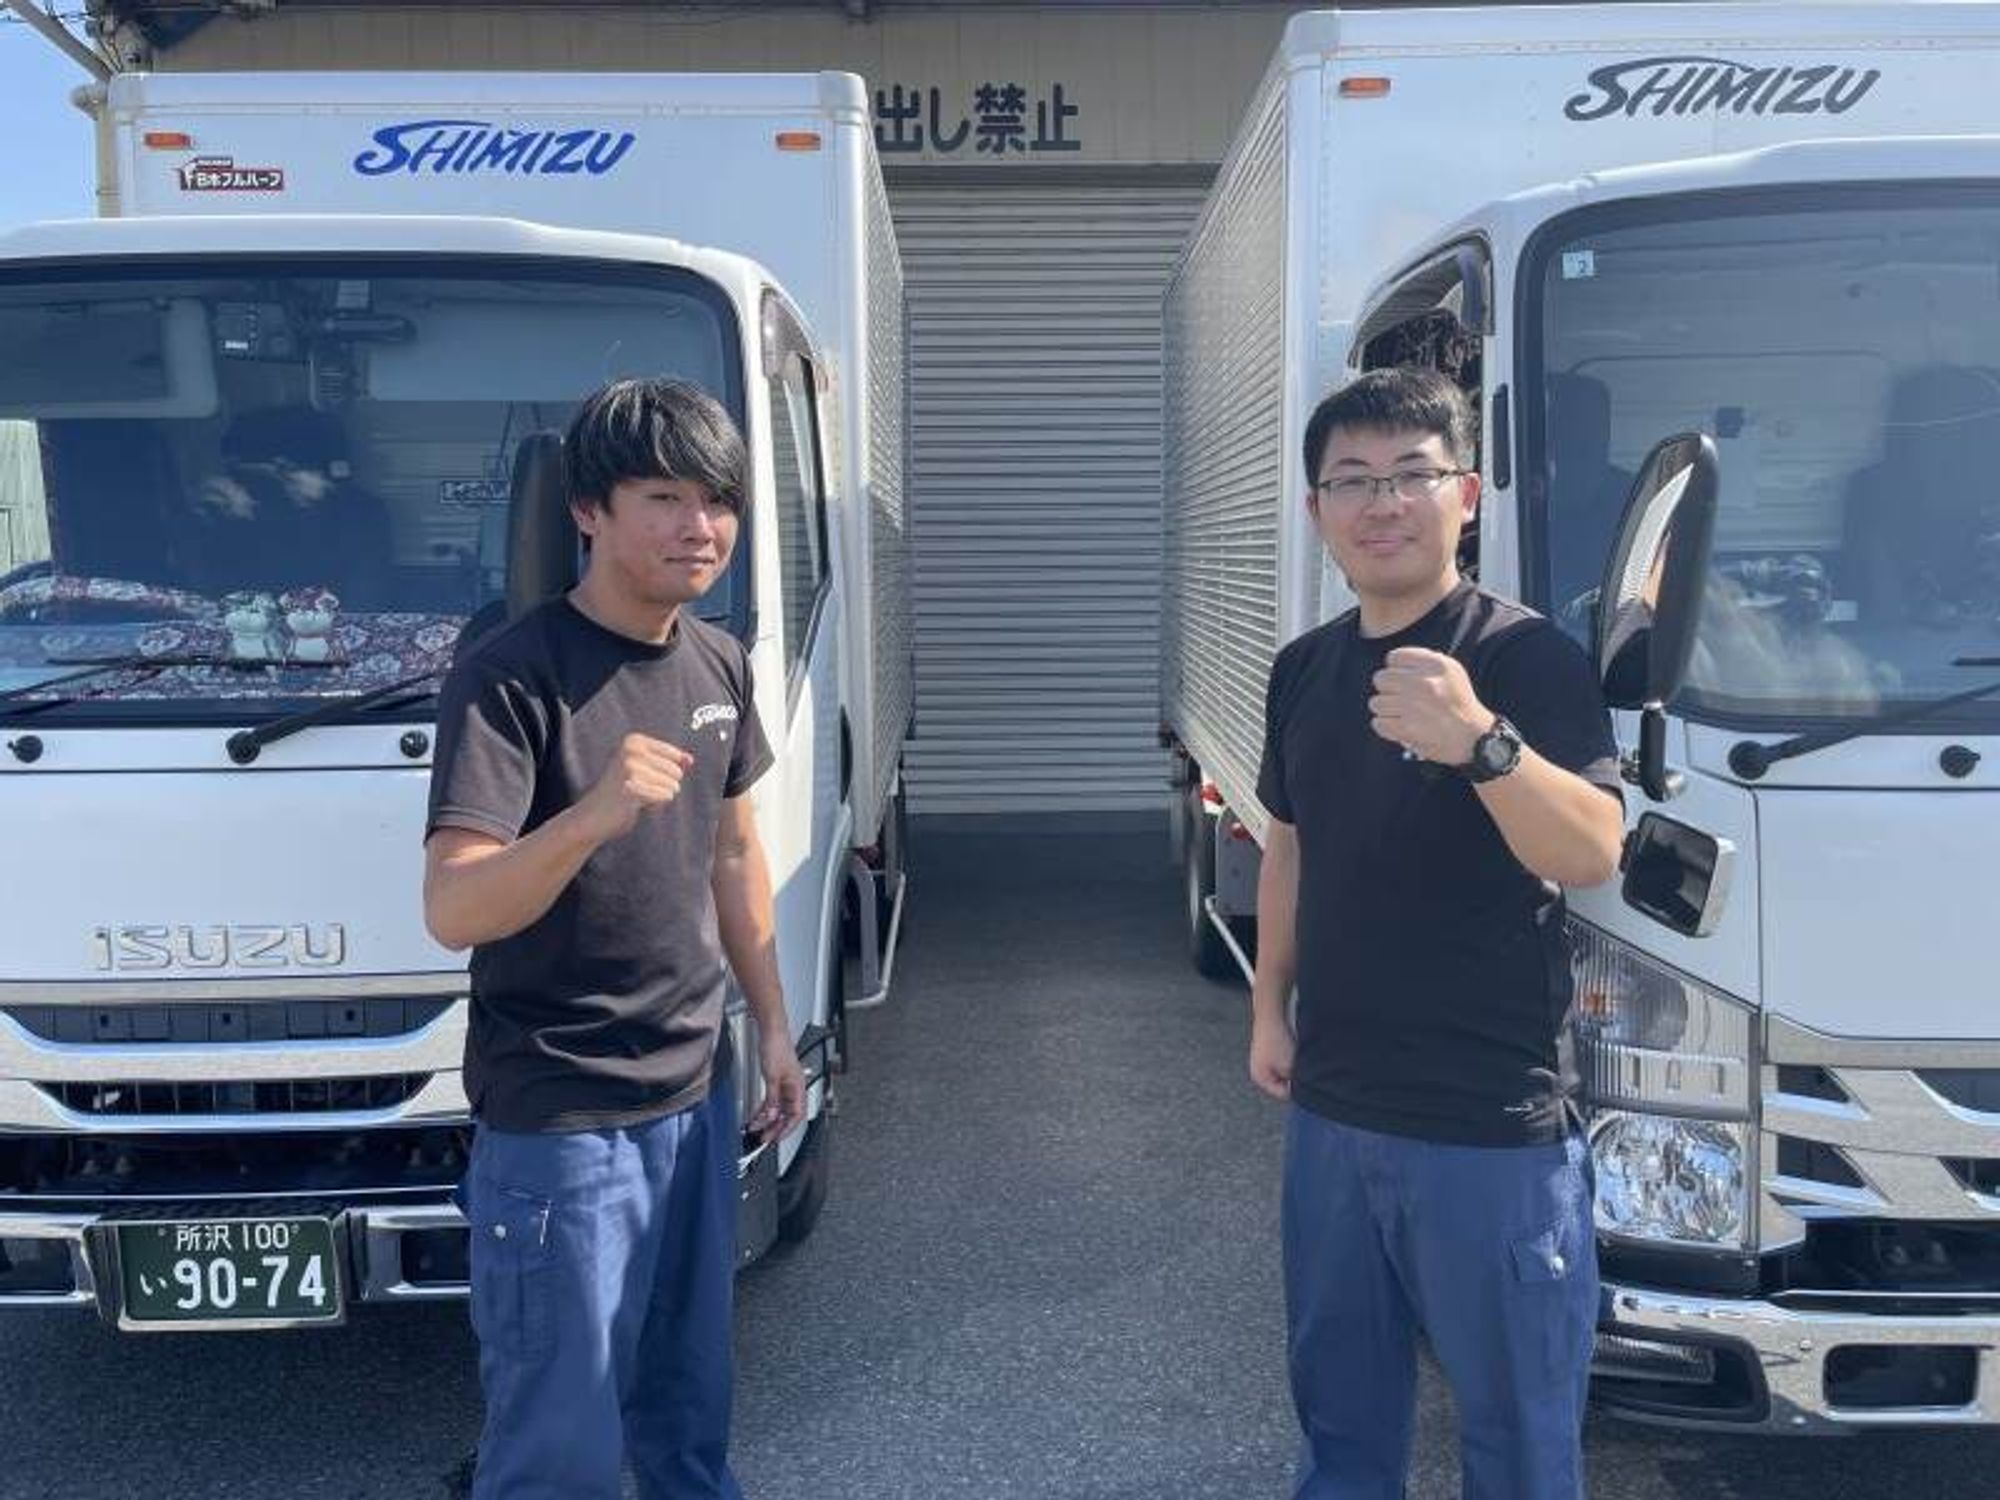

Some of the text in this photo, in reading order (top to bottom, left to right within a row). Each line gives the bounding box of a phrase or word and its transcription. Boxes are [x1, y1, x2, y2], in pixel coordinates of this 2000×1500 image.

[1563, 56, 1881, 121] SHIMIZU
[874, 82, 1081, 153] 出し禁止
[353, 120, 636, 175] SHIMIZU
[96, 924, 345, 970] ISUZU
[176, 1223, 290, 1251] 所沢 100
[139, 1254, 326, 1309] い 90-74
